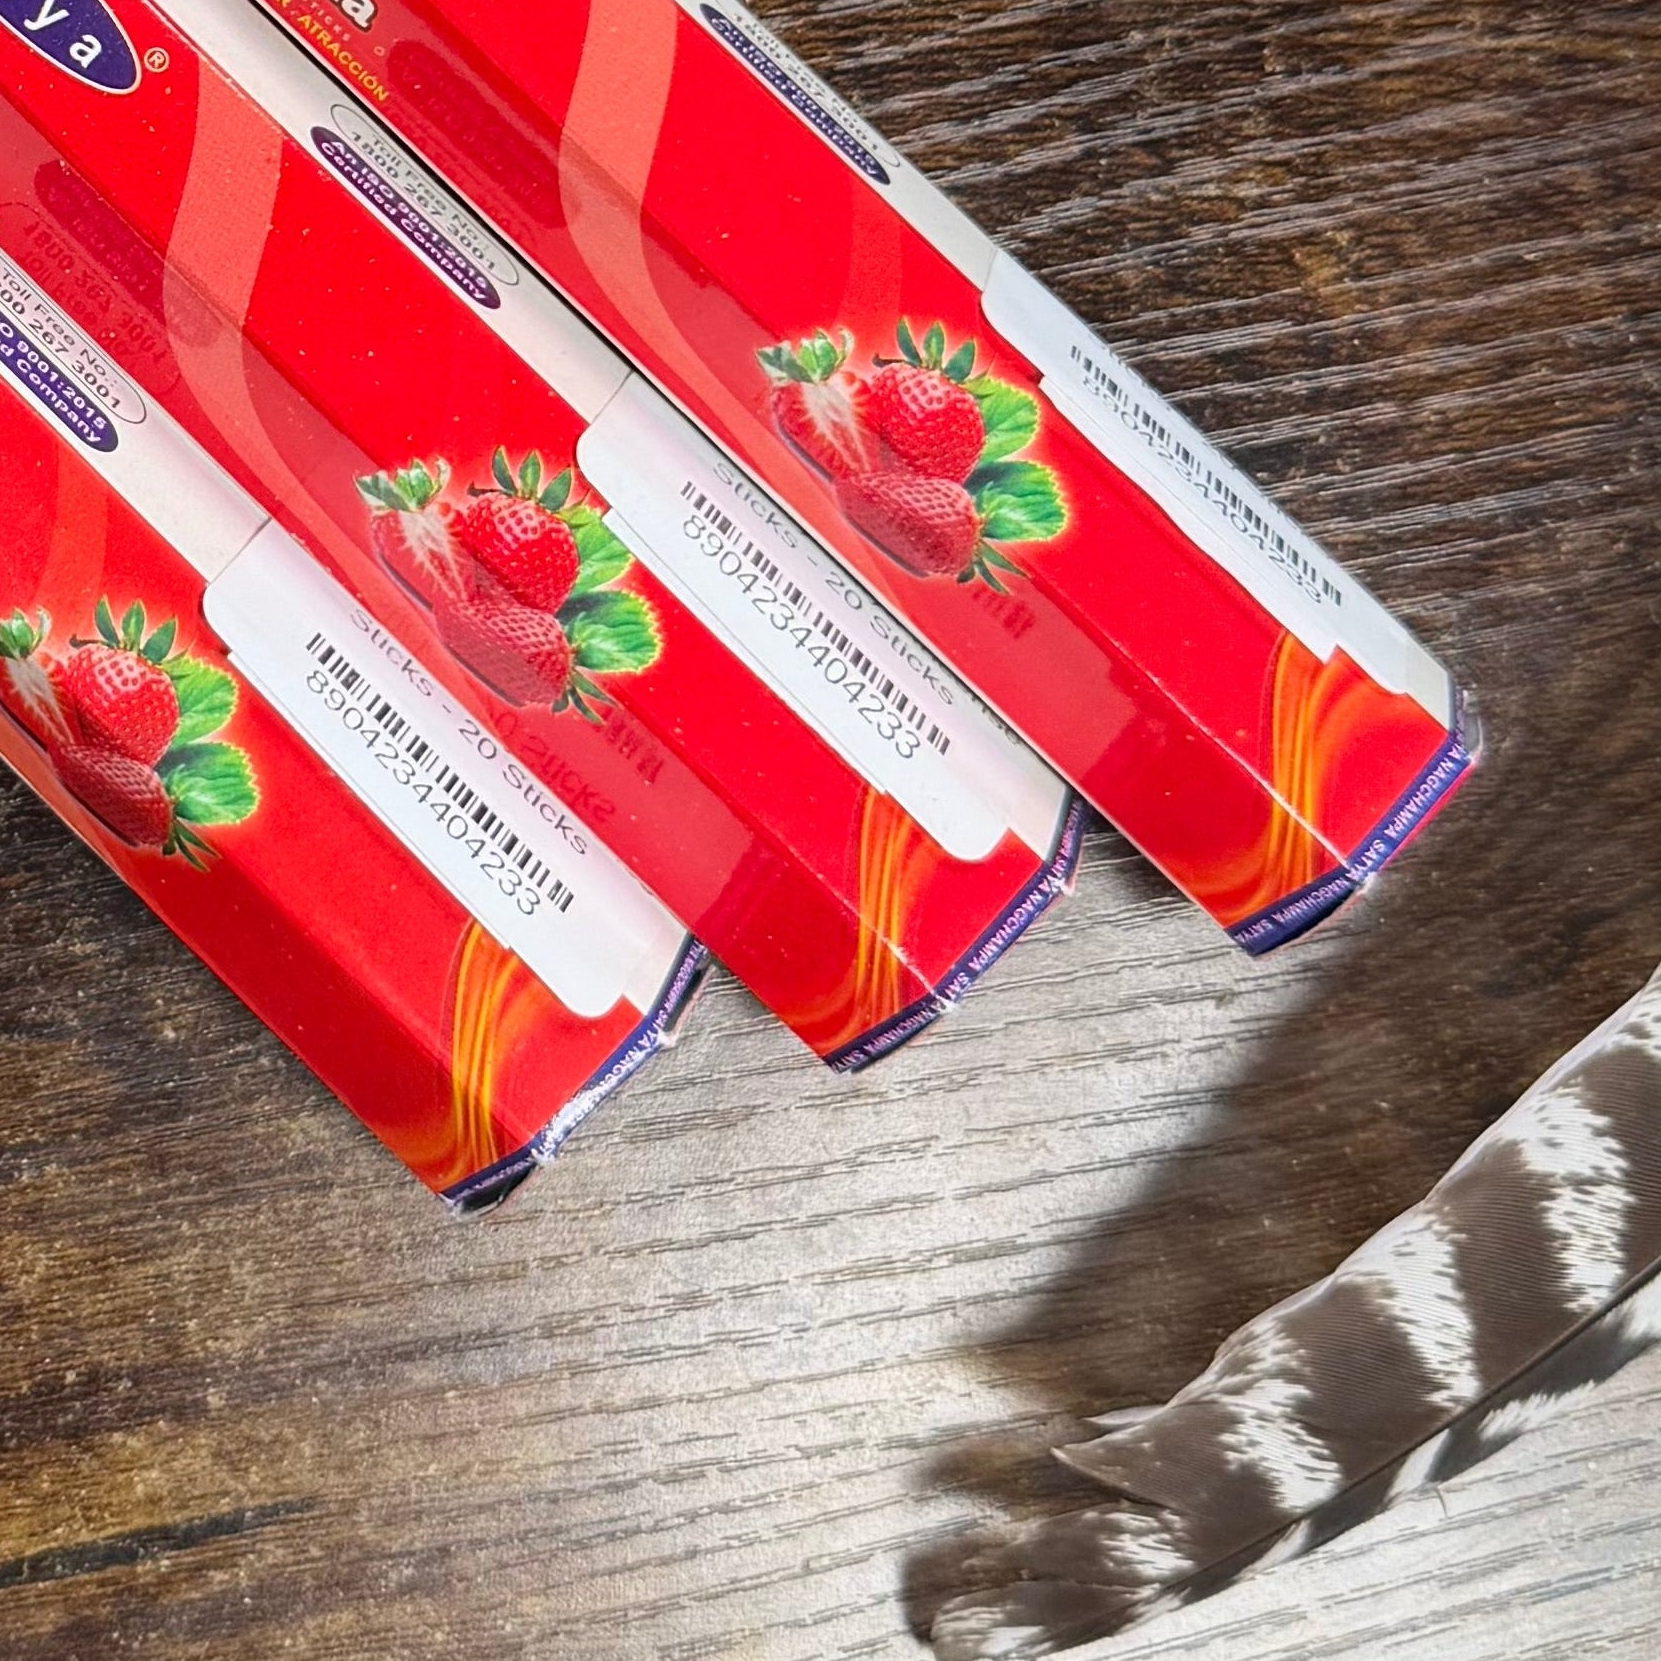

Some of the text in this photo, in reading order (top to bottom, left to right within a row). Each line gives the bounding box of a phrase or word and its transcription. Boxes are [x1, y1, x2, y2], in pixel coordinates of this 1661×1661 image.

[297, 15, 388, 100] ATRACCIÓN
[321, 141, 484, 306] Certified Company
[330, 135, 486, 293] An ISO 9001:2015
[352, 131, 495, 269] 1800 267 3001
[2, 267, 32, 300] Toll
[33, 303, 75, 346] Free
[28, 317, 69, 360] 267
[71, 359, 120, 412] 3001
[16, 340, 106, 429] 9001:2015
[16, 358, 100, 444] Company
[683, 515, 920, 758] 8904234404233
[713, 462, 796, 548] Sticks
[824, 570, 863, 610] 20
[869, 614, 952, 704] Sticks
[350, 609, 432, 696] Sticks
[458, 718, 497, 760] 20
[502, 763, 587, 854] Sticks
[306, 670, 540, 914] 8904234404233
[1382, 756, 1460, 842] NAGCHAMPA
[967, 886, 1044, 972] NAGCHAMPA
